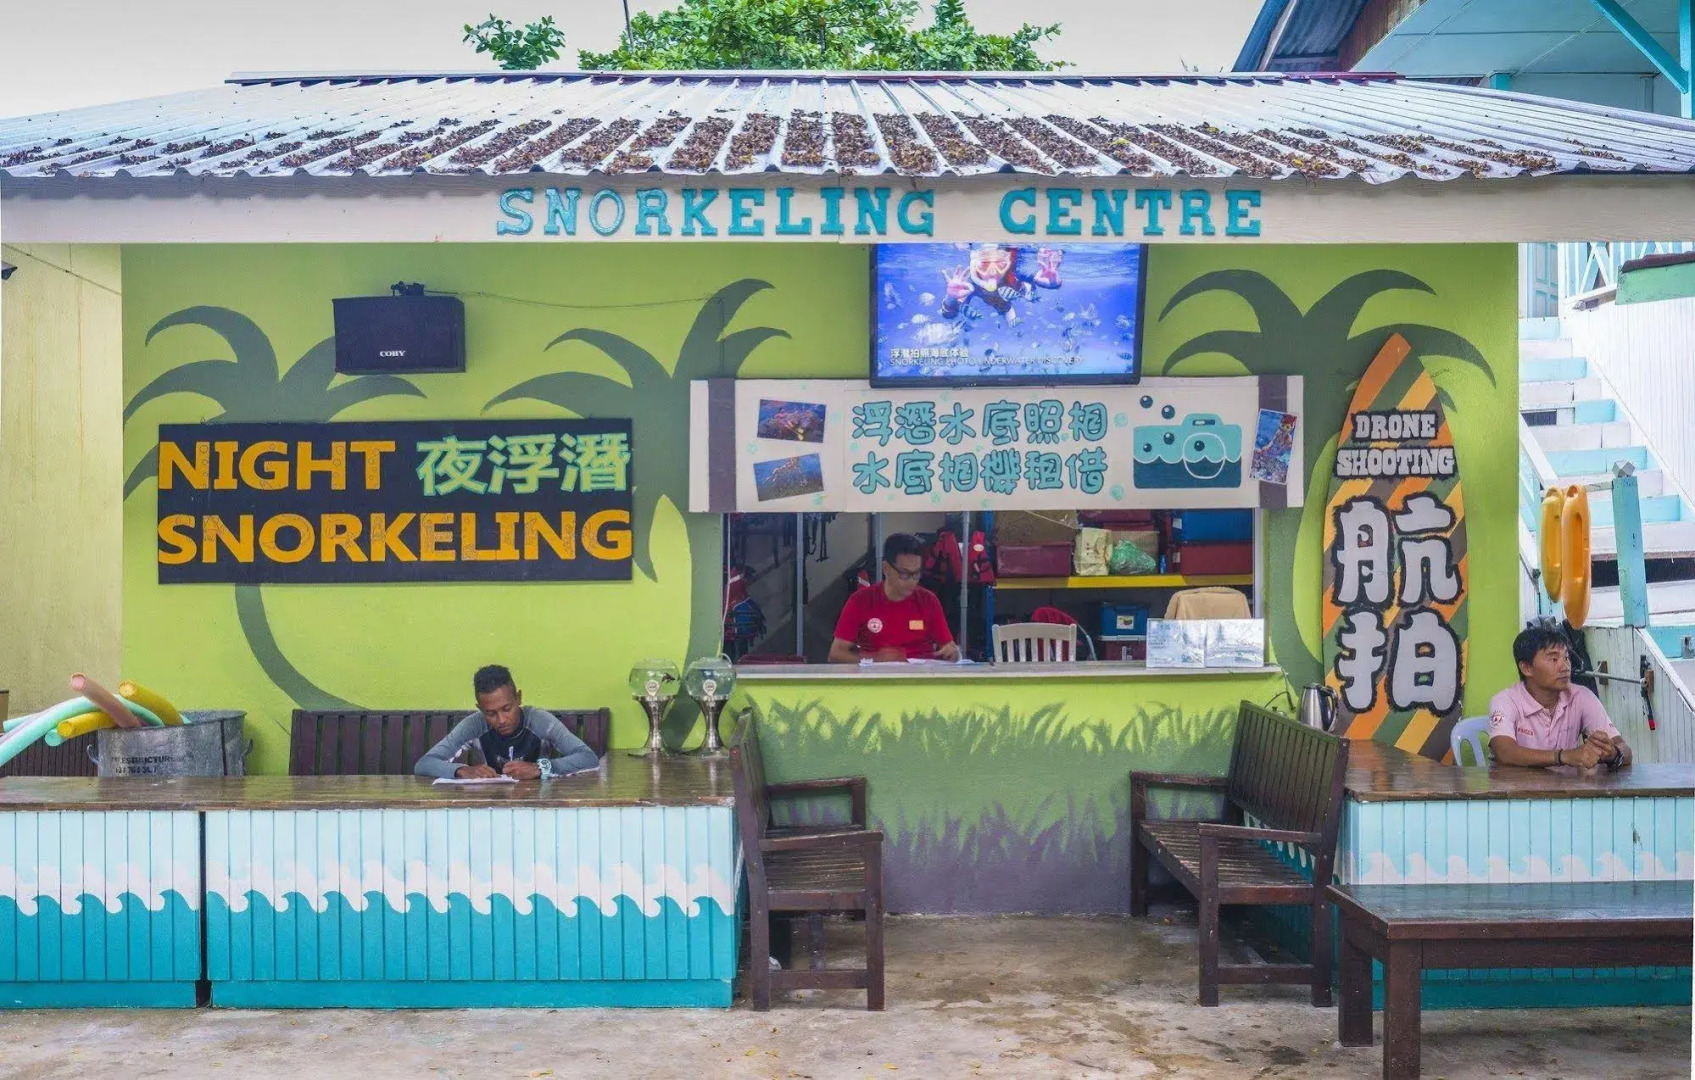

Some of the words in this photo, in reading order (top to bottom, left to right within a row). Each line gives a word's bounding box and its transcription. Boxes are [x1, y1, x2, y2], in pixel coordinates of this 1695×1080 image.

[496, 187, 935, 237] SNORKELING
[999, 187, 1262, 237] CENTRE
[379, 350, 406, 358] COBY
[890, 358, 944, 366] SNORKELING
[946, 357, 976, 366] PHOTO
[1354, 413, 1437, 440] DRONE
[158, 440, 395, 492] NIGHT
[415, 432, 631, 497] 夜浮潛
[852, 446, 1109, 496] 水底相機租借
[1335, 447, 1456, 476] SHOOTING
[158, 508, 633, 565] SNORKELING
[1335, 495, 1463, 713] 航拍
